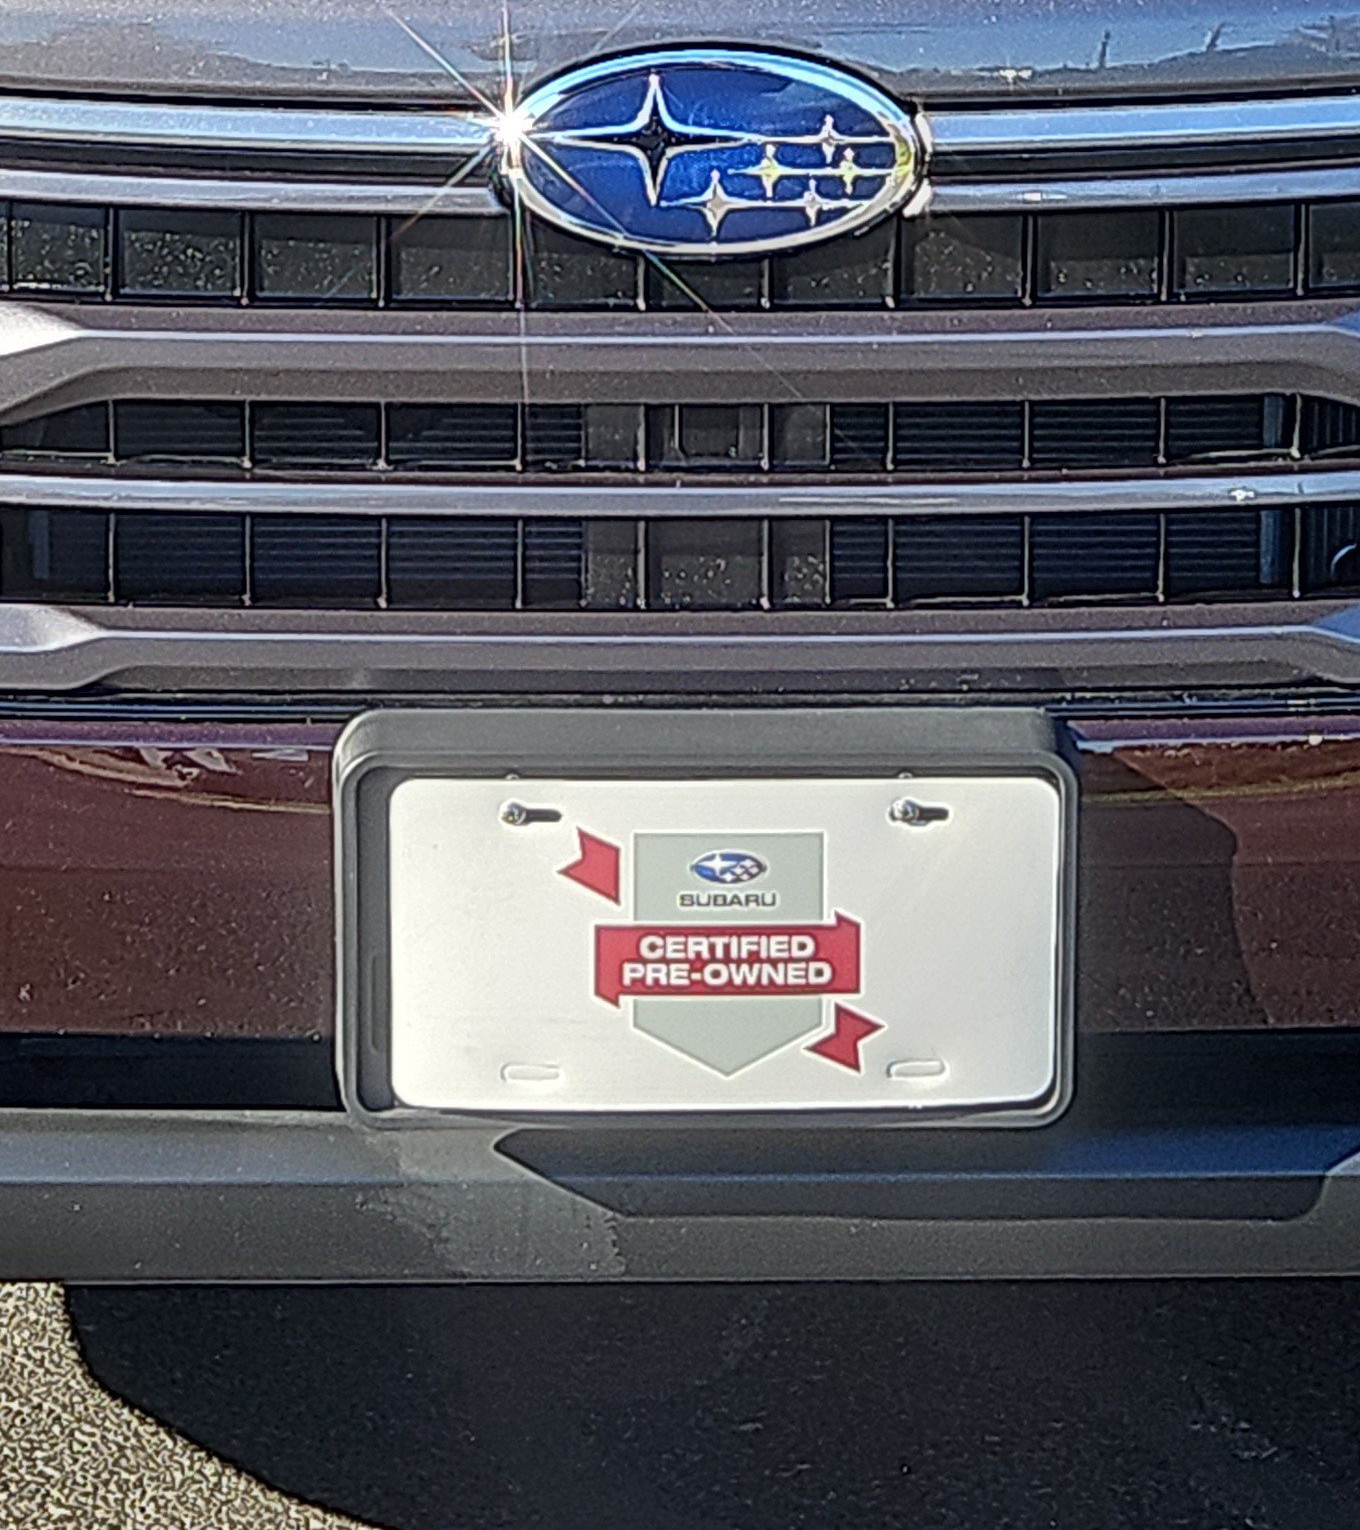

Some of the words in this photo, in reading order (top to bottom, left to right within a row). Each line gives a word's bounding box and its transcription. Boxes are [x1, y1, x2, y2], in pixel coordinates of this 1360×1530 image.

[678, 892, 777, 908] SUBARU
[638, 934, 816, 960] CERTIFIED
[621, 961, 833, 987] PRE-OWNED
